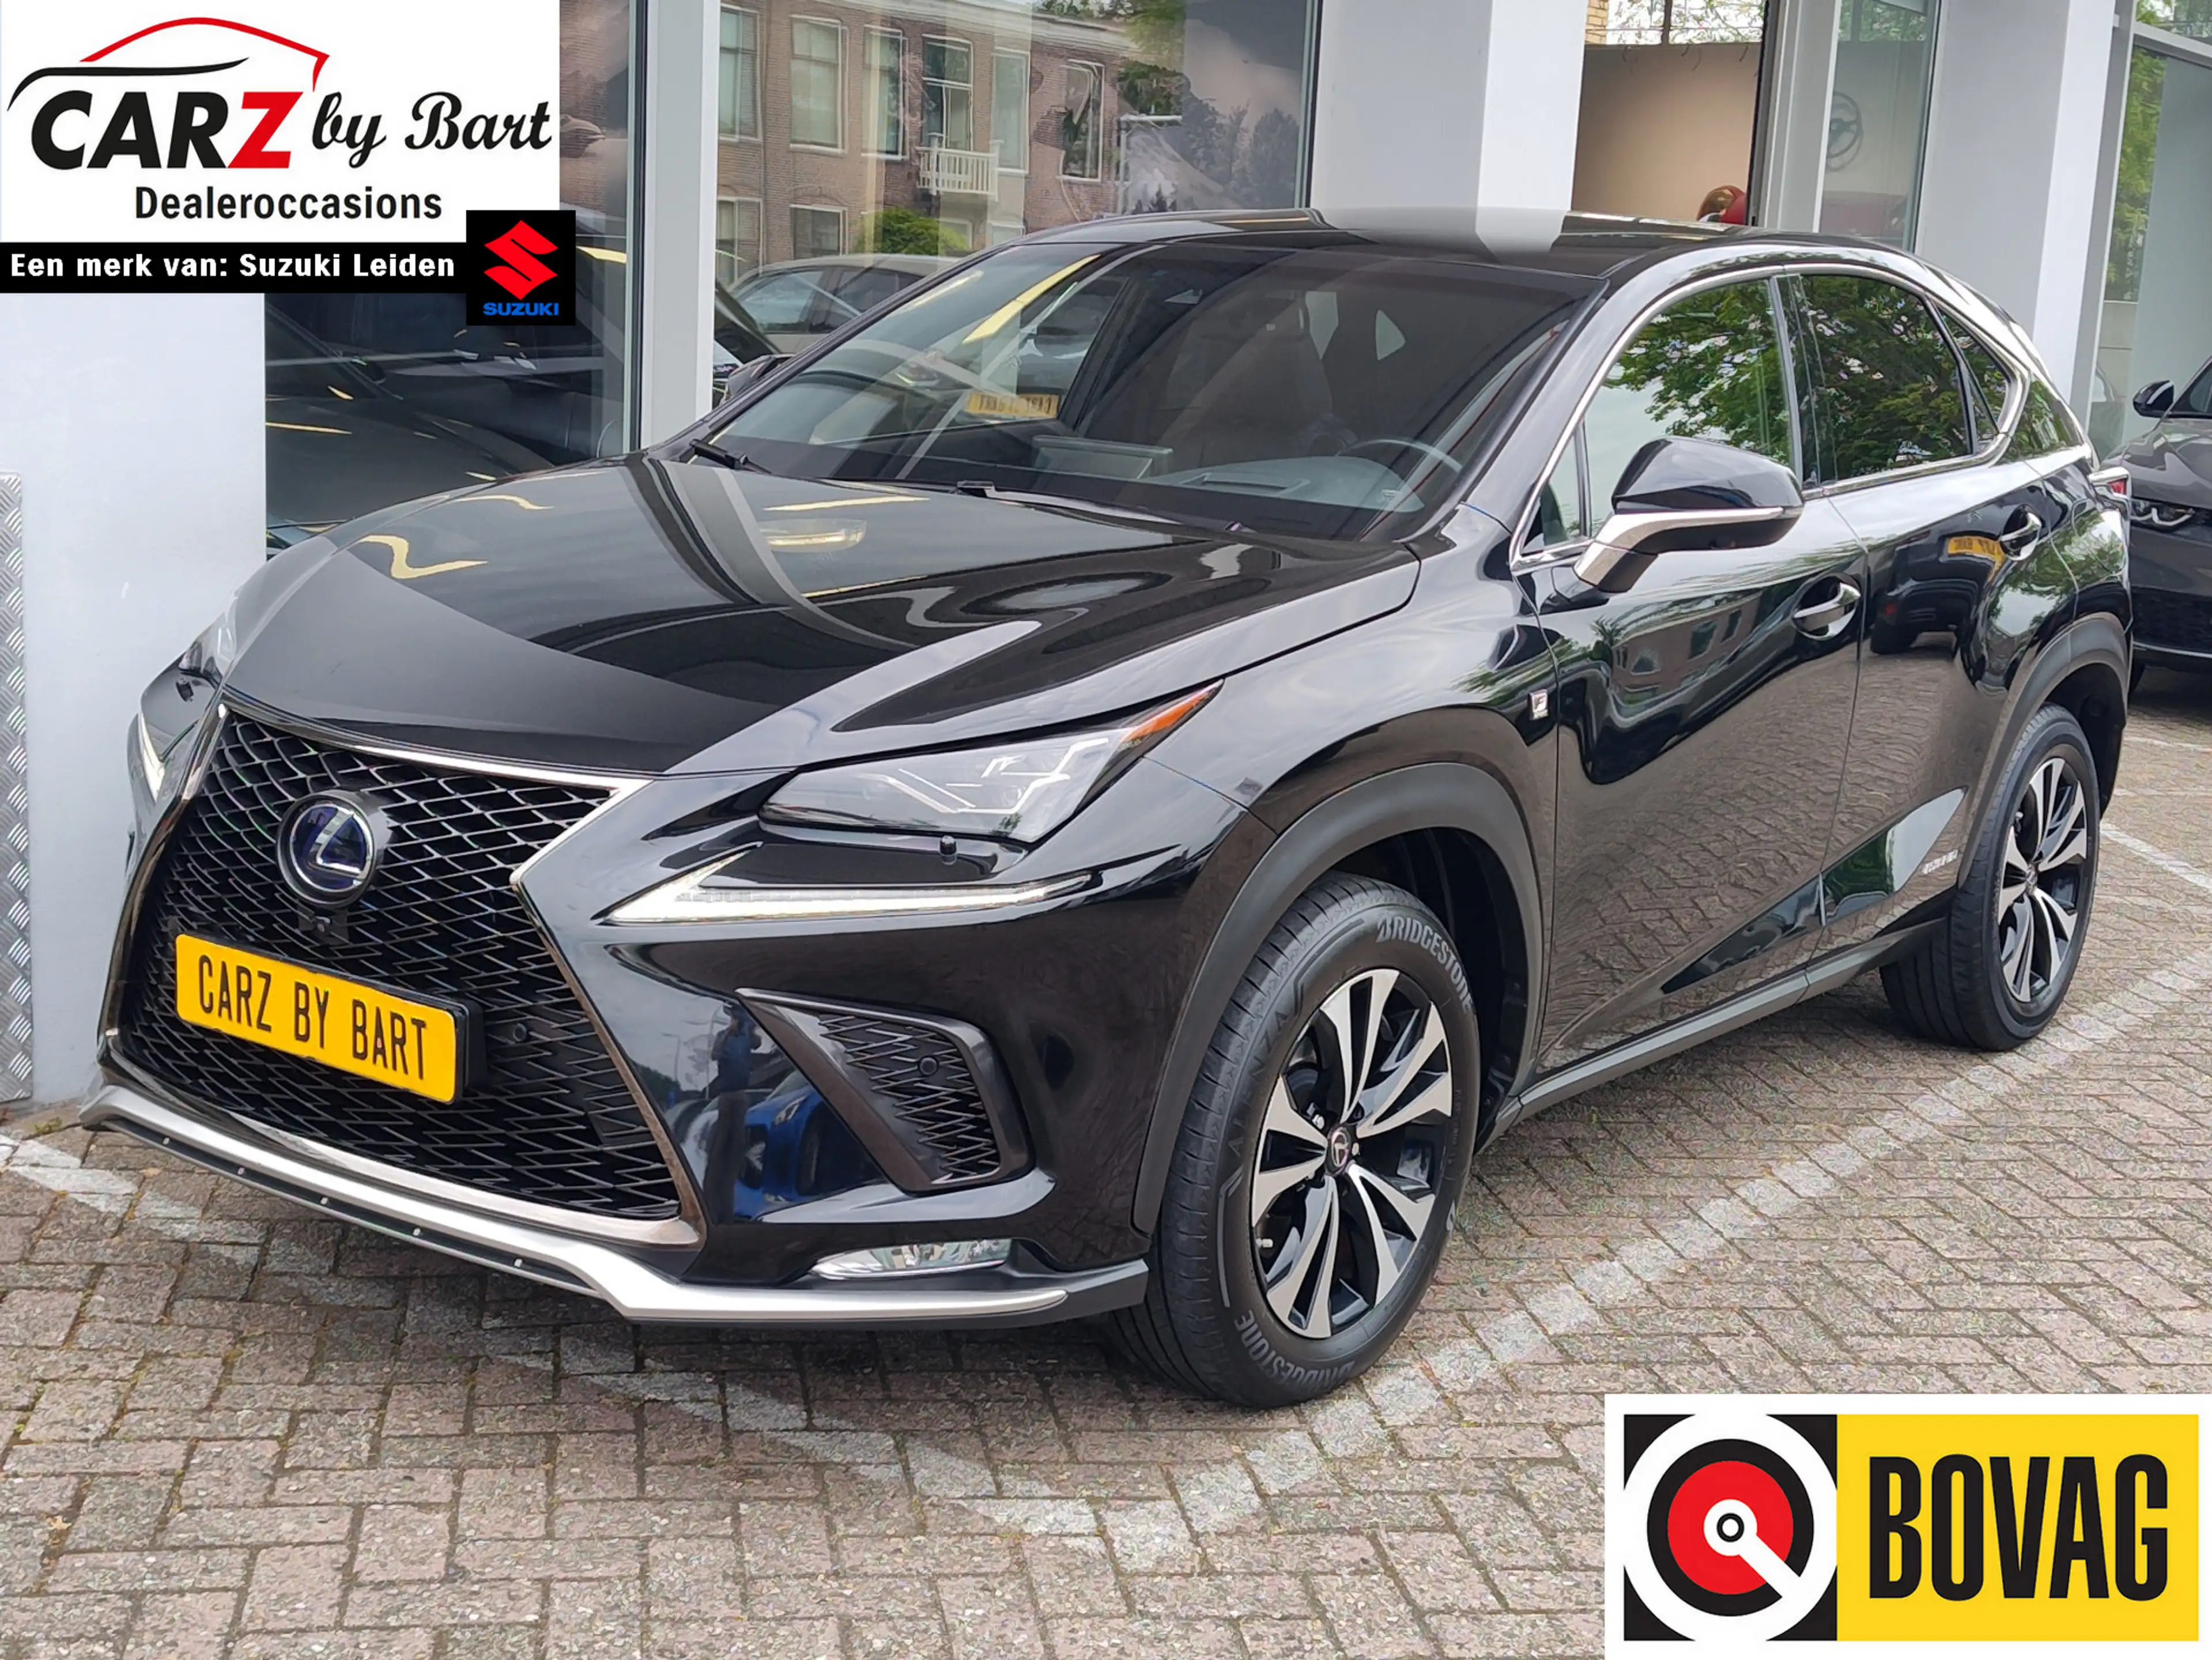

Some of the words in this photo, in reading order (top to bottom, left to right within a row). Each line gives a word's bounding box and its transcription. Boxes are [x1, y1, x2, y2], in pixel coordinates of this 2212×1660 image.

[198, 954, 273, 1033] CARZ
[294, 982, 329, 1048] BY
[352, 999, 427, 1080] BART
[1375, 915, 1474, 1013] BRIDGESTONE
